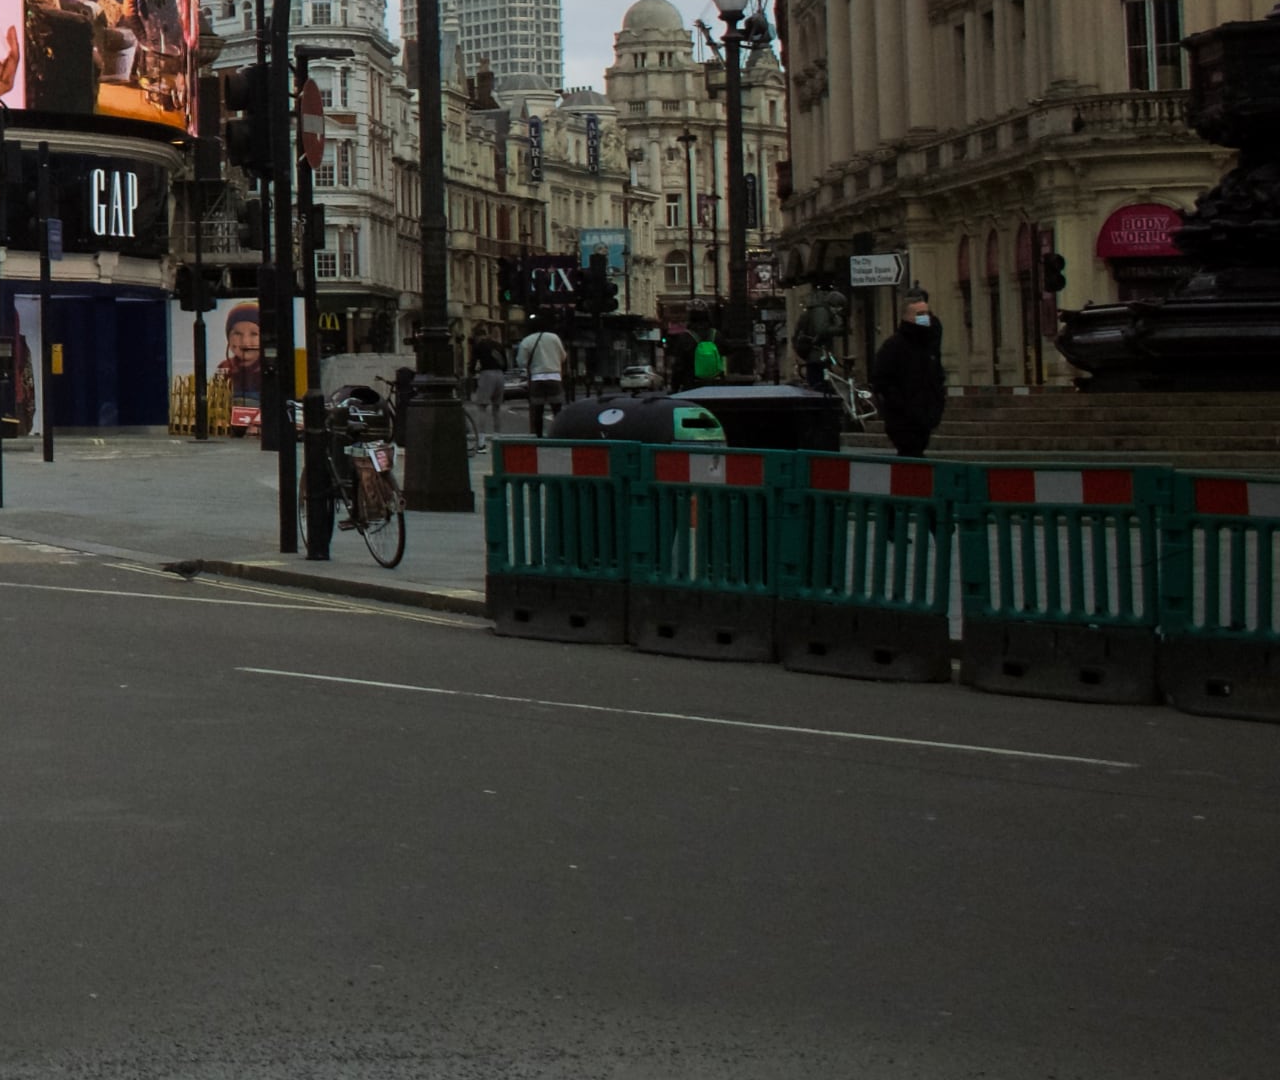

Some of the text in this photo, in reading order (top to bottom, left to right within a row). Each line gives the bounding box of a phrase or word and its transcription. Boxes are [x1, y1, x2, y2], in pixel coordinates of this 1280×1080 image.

[530, 127, 541, 178] LYRIC
[587, 122, 598, 174] APOLLO
[90, 168, 139, 238] GAP
[1121, 216, 1170, 231] BODY
[1111, 231, 1173, 245] WORLD
